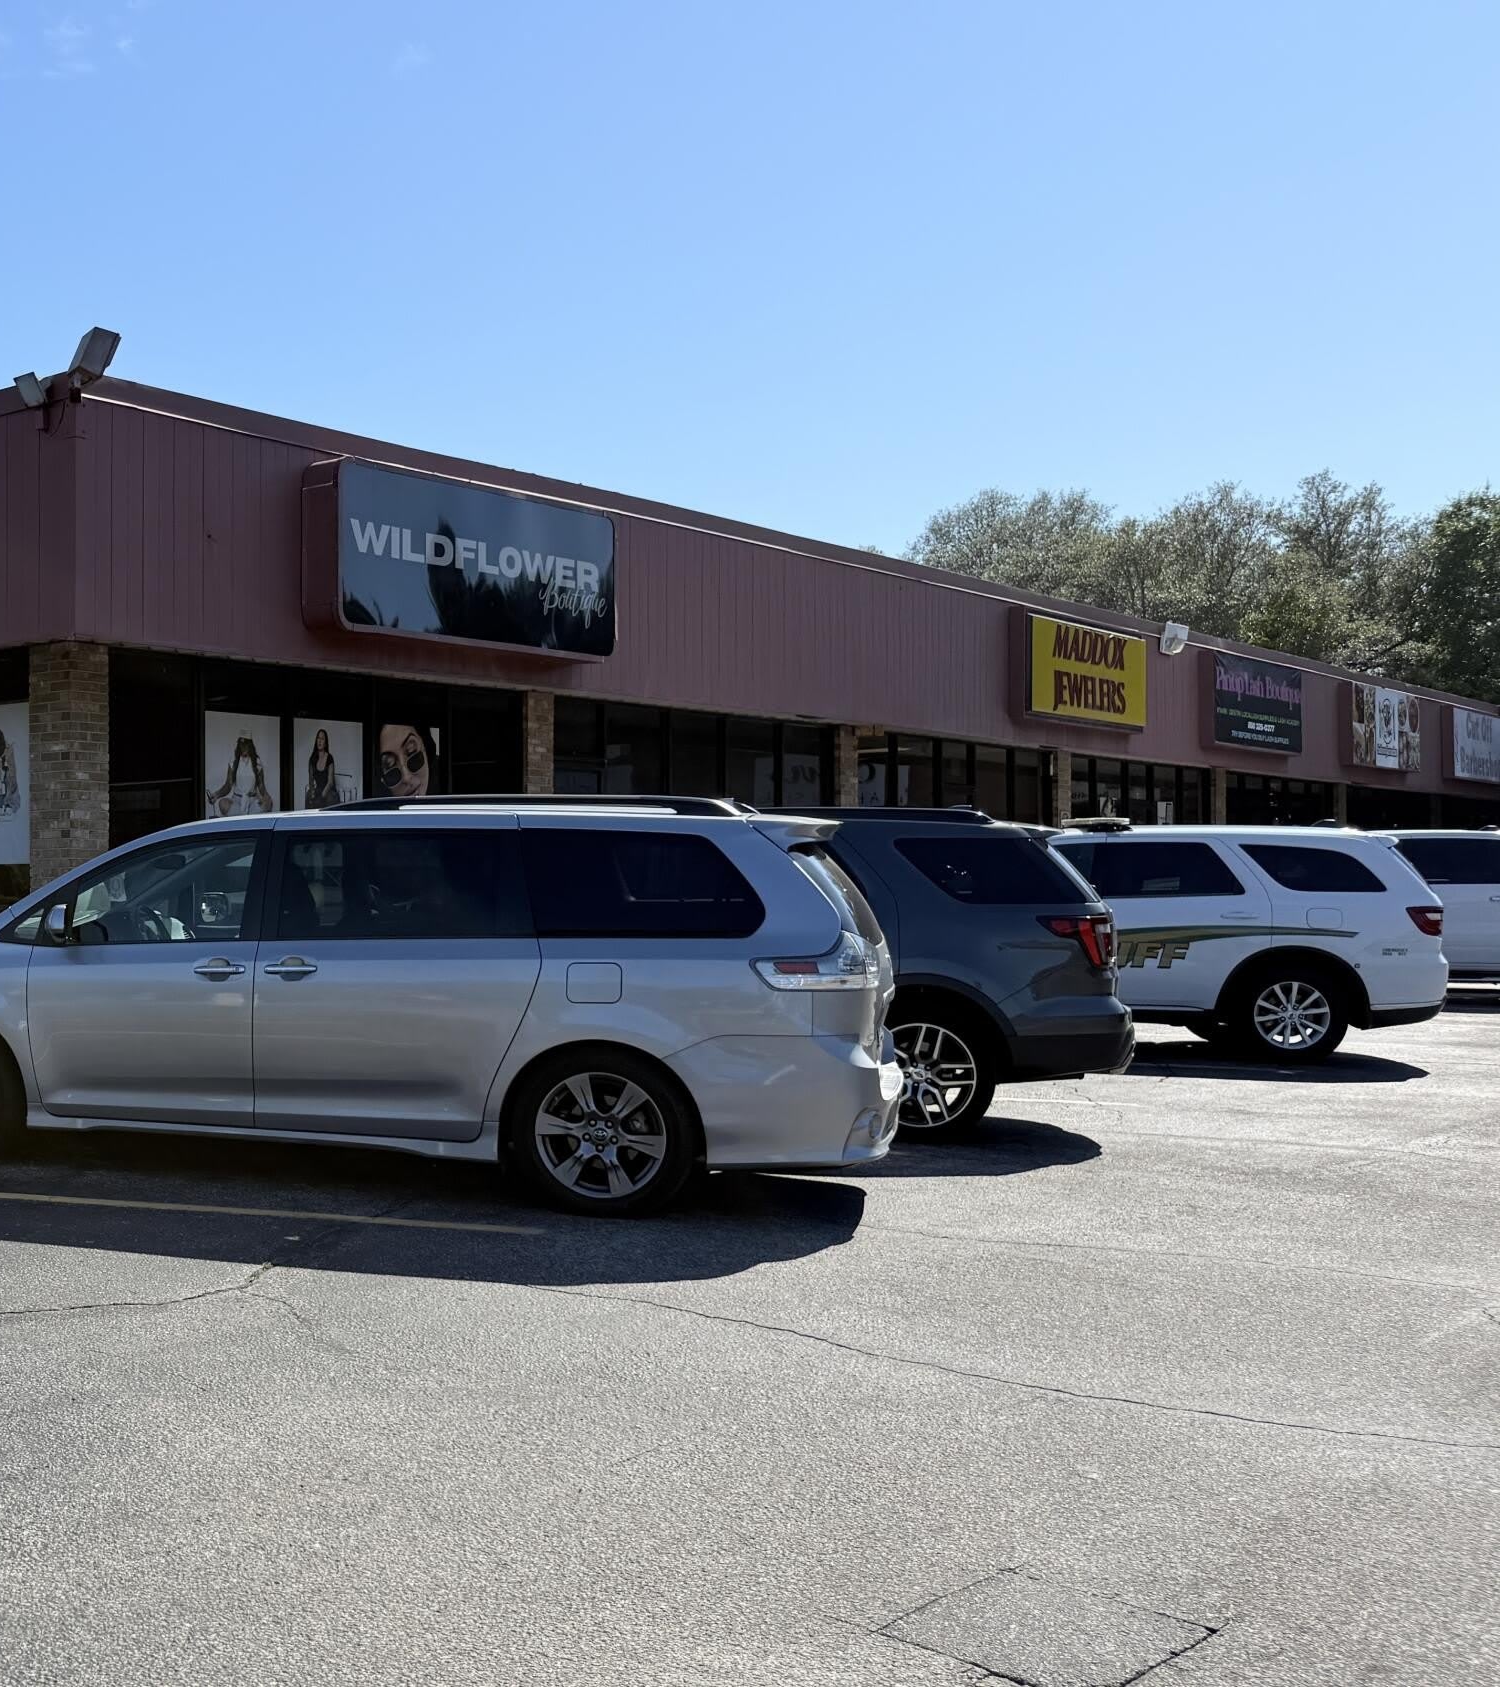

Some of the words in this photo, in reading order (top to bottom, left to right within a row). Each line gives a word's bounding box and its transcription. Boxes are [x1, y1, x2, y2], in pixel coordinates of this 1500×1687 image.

[350, 518, 599, 592] WILDFLOWER
[539, 576, 607, 628] Boutique
[1052, 624, 1127, 671] MADDOX
[1053, 669, 1126, 715] JEWELERS
[1460, 746, 1500, 778] Barbersho
